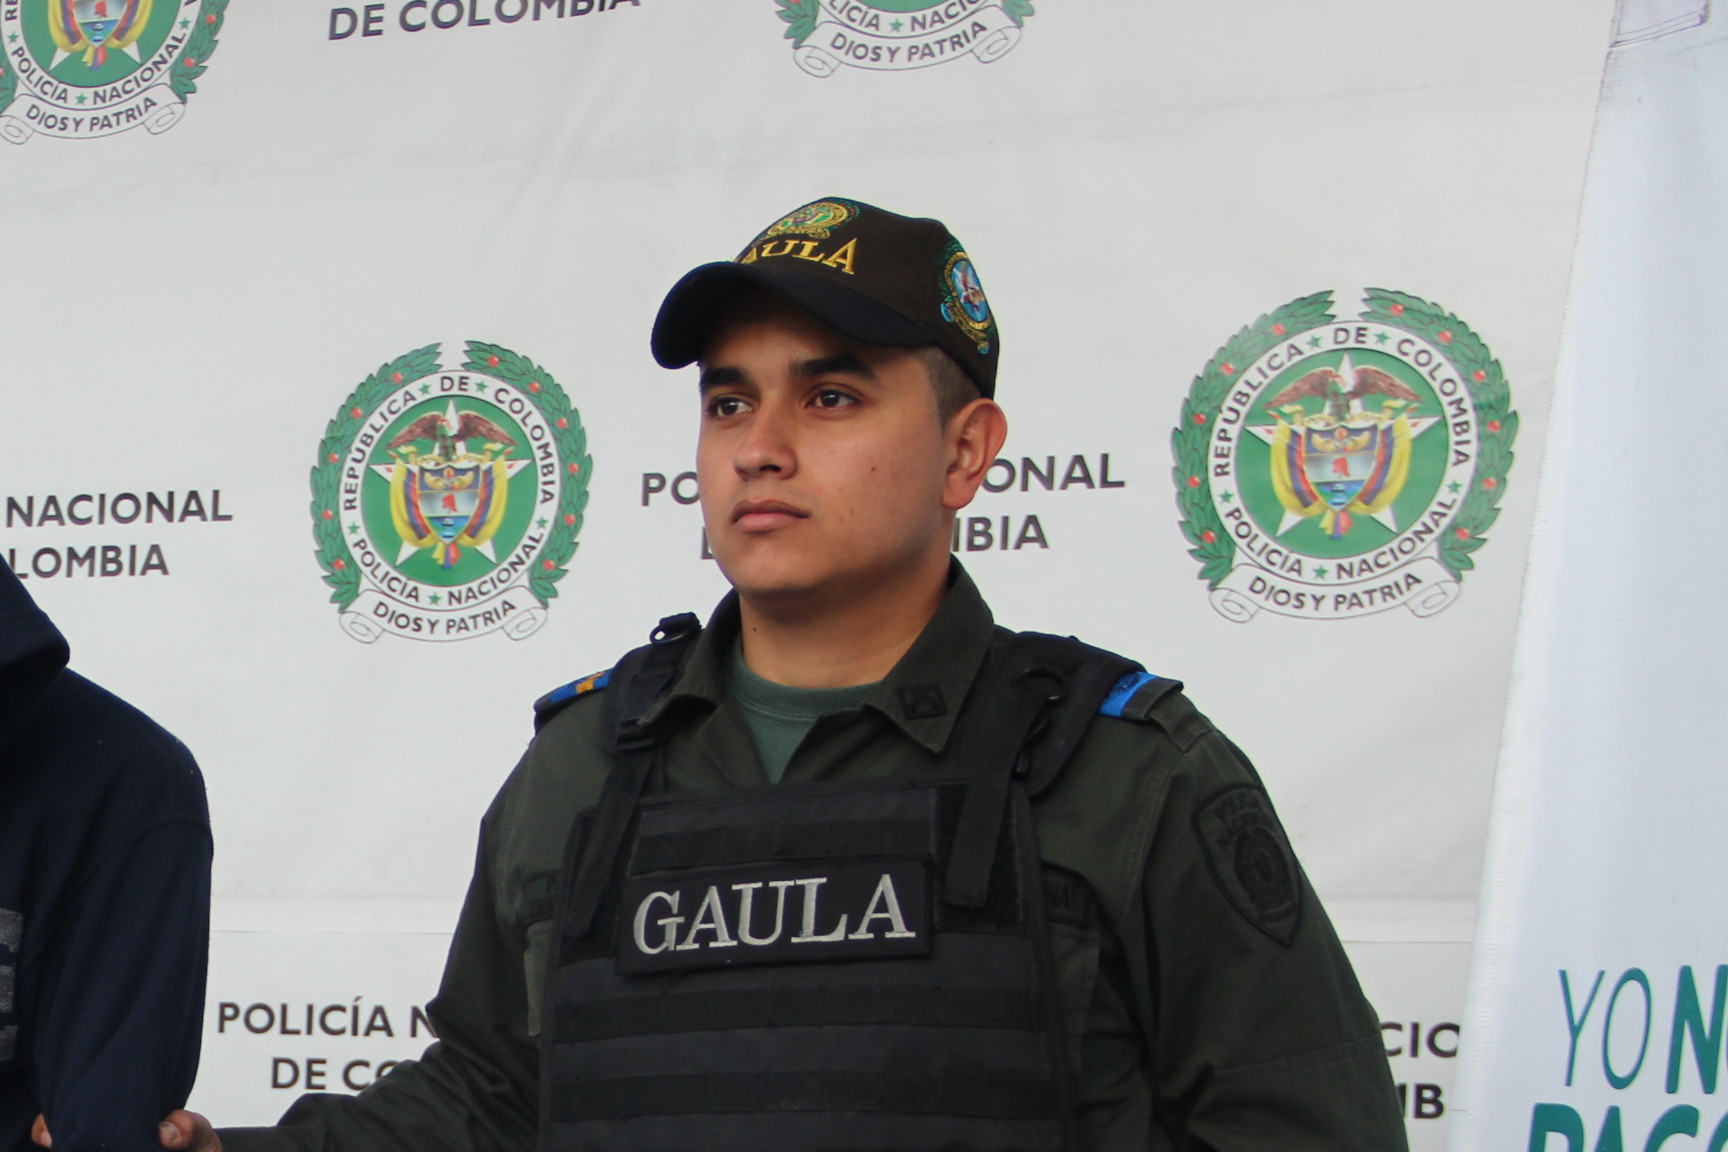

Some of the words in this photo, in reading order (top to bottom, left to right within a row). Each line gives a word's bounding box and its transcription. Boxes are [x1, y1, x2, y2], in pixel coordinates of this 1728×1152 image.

[328, 3, 386, 41] DE
[909, 22, 985, 62] PATRIA
[94, 33, 185, 105] NACIONAL
[91, 97, 155, 132] PATRIA
[1333, 326, 1366, 343] DE
[1397, 339, 1470, 466] COLOMBIA
[441, 376, 468, 391] DE
[494, 388, 555, 504] COLOMBIA
[981, 453, 1125, 494] ONAL
[6, 489, 233, 528] NACIONAL
[1339, 498, 1455, 579] NACIONAL
[9, 544, 170, 580] LOMBIA
[448, 533, 543, 605] NACIONAL
[1336, 573, 1420, 611] PATRIA
[446, 600, 515, 634] PATRIA
[632, 872, 916, 955] GAULA
[217, 995, 395, 1038] POLICÍA
[1558, 967, 1652, 1090] YO
[1665, 964, 1728, 1094] N
[271, 1057, 327, 1091] DE
